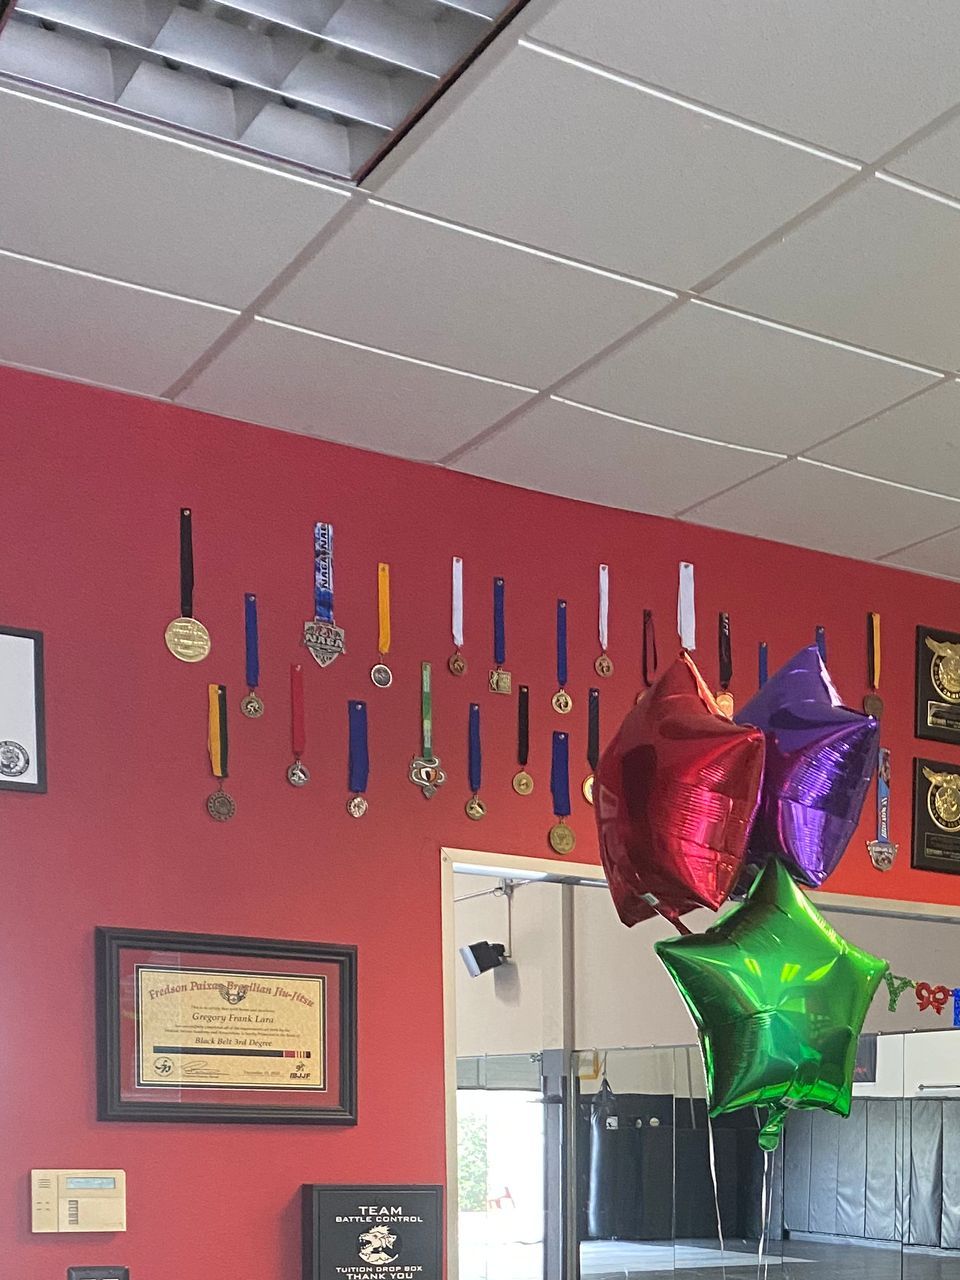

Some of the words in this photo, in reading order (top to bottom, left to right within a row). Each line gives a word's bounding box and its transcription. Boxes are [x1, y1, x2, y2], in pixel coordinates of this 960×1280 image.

[305, 633, 343, 649] NAGA
[149, 984, 187, 1000] Fredson
[273, 986, 315, 1007] Jiu-Jitsu
[192, 1012, 226, 1023] Gregory
[229, 1013, 253, 1023] Frank
[255, 1015, 274, 1023] Lara
[195, 1036, 215, 1045] Black
[217, 1037, 232, 1046] Belt
[234, 1038, 247, 1046] 3rd
[249, 1038, 272, 1049] Degree
[358, 1206, 402, 1215] TEAM
